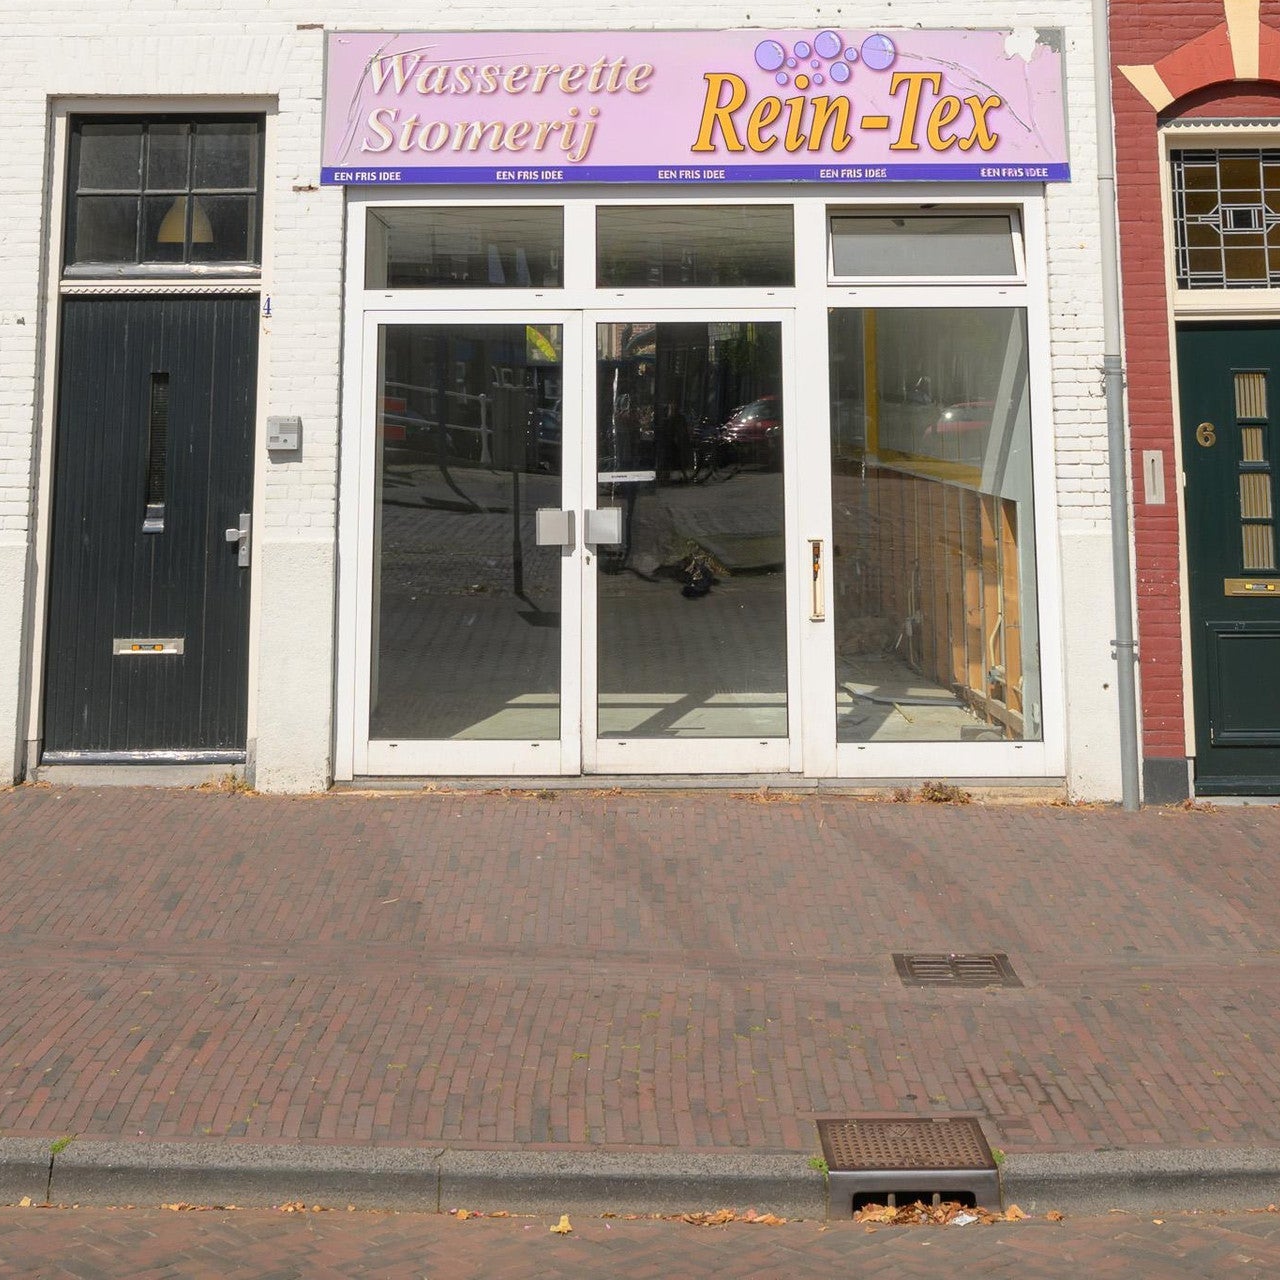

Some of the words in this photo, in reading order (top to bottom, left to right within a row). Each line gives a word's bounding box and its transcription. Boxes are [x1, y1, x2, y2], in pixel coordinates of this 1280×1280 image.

[367, 55, 654, 95] Wasserette
[690, 71, 1003, 153] Rein-Tex
[361, 106, 601, 163] Stomerij
[334, 172, 353, 181] EEN
[355, 172, 376, 181] FRIS
[379, 172, 401, 181] IDEE
[496, 171, 515, 180] EEN
[517, 171, 538, 180] FRIS
[541, 171, 563, 180] IDEE
[658, 170, 677, 179] EEN
[679, 170, 701, 179] FRIS
[703, 170, 725, 179] IDEE
[820, 169, 839, 178] EEN
[841, 169, 862, 178] FRIS
[865, 169, 887, 178] IDEE
[980, 168, 1000, 177] EEN
[1002, 168, 1024, 177] FRIS
[1026, 168, 1048, 177] IDEE
[263, 297, 272, 315] 4
[1196, 422, 1217, 448] 6
